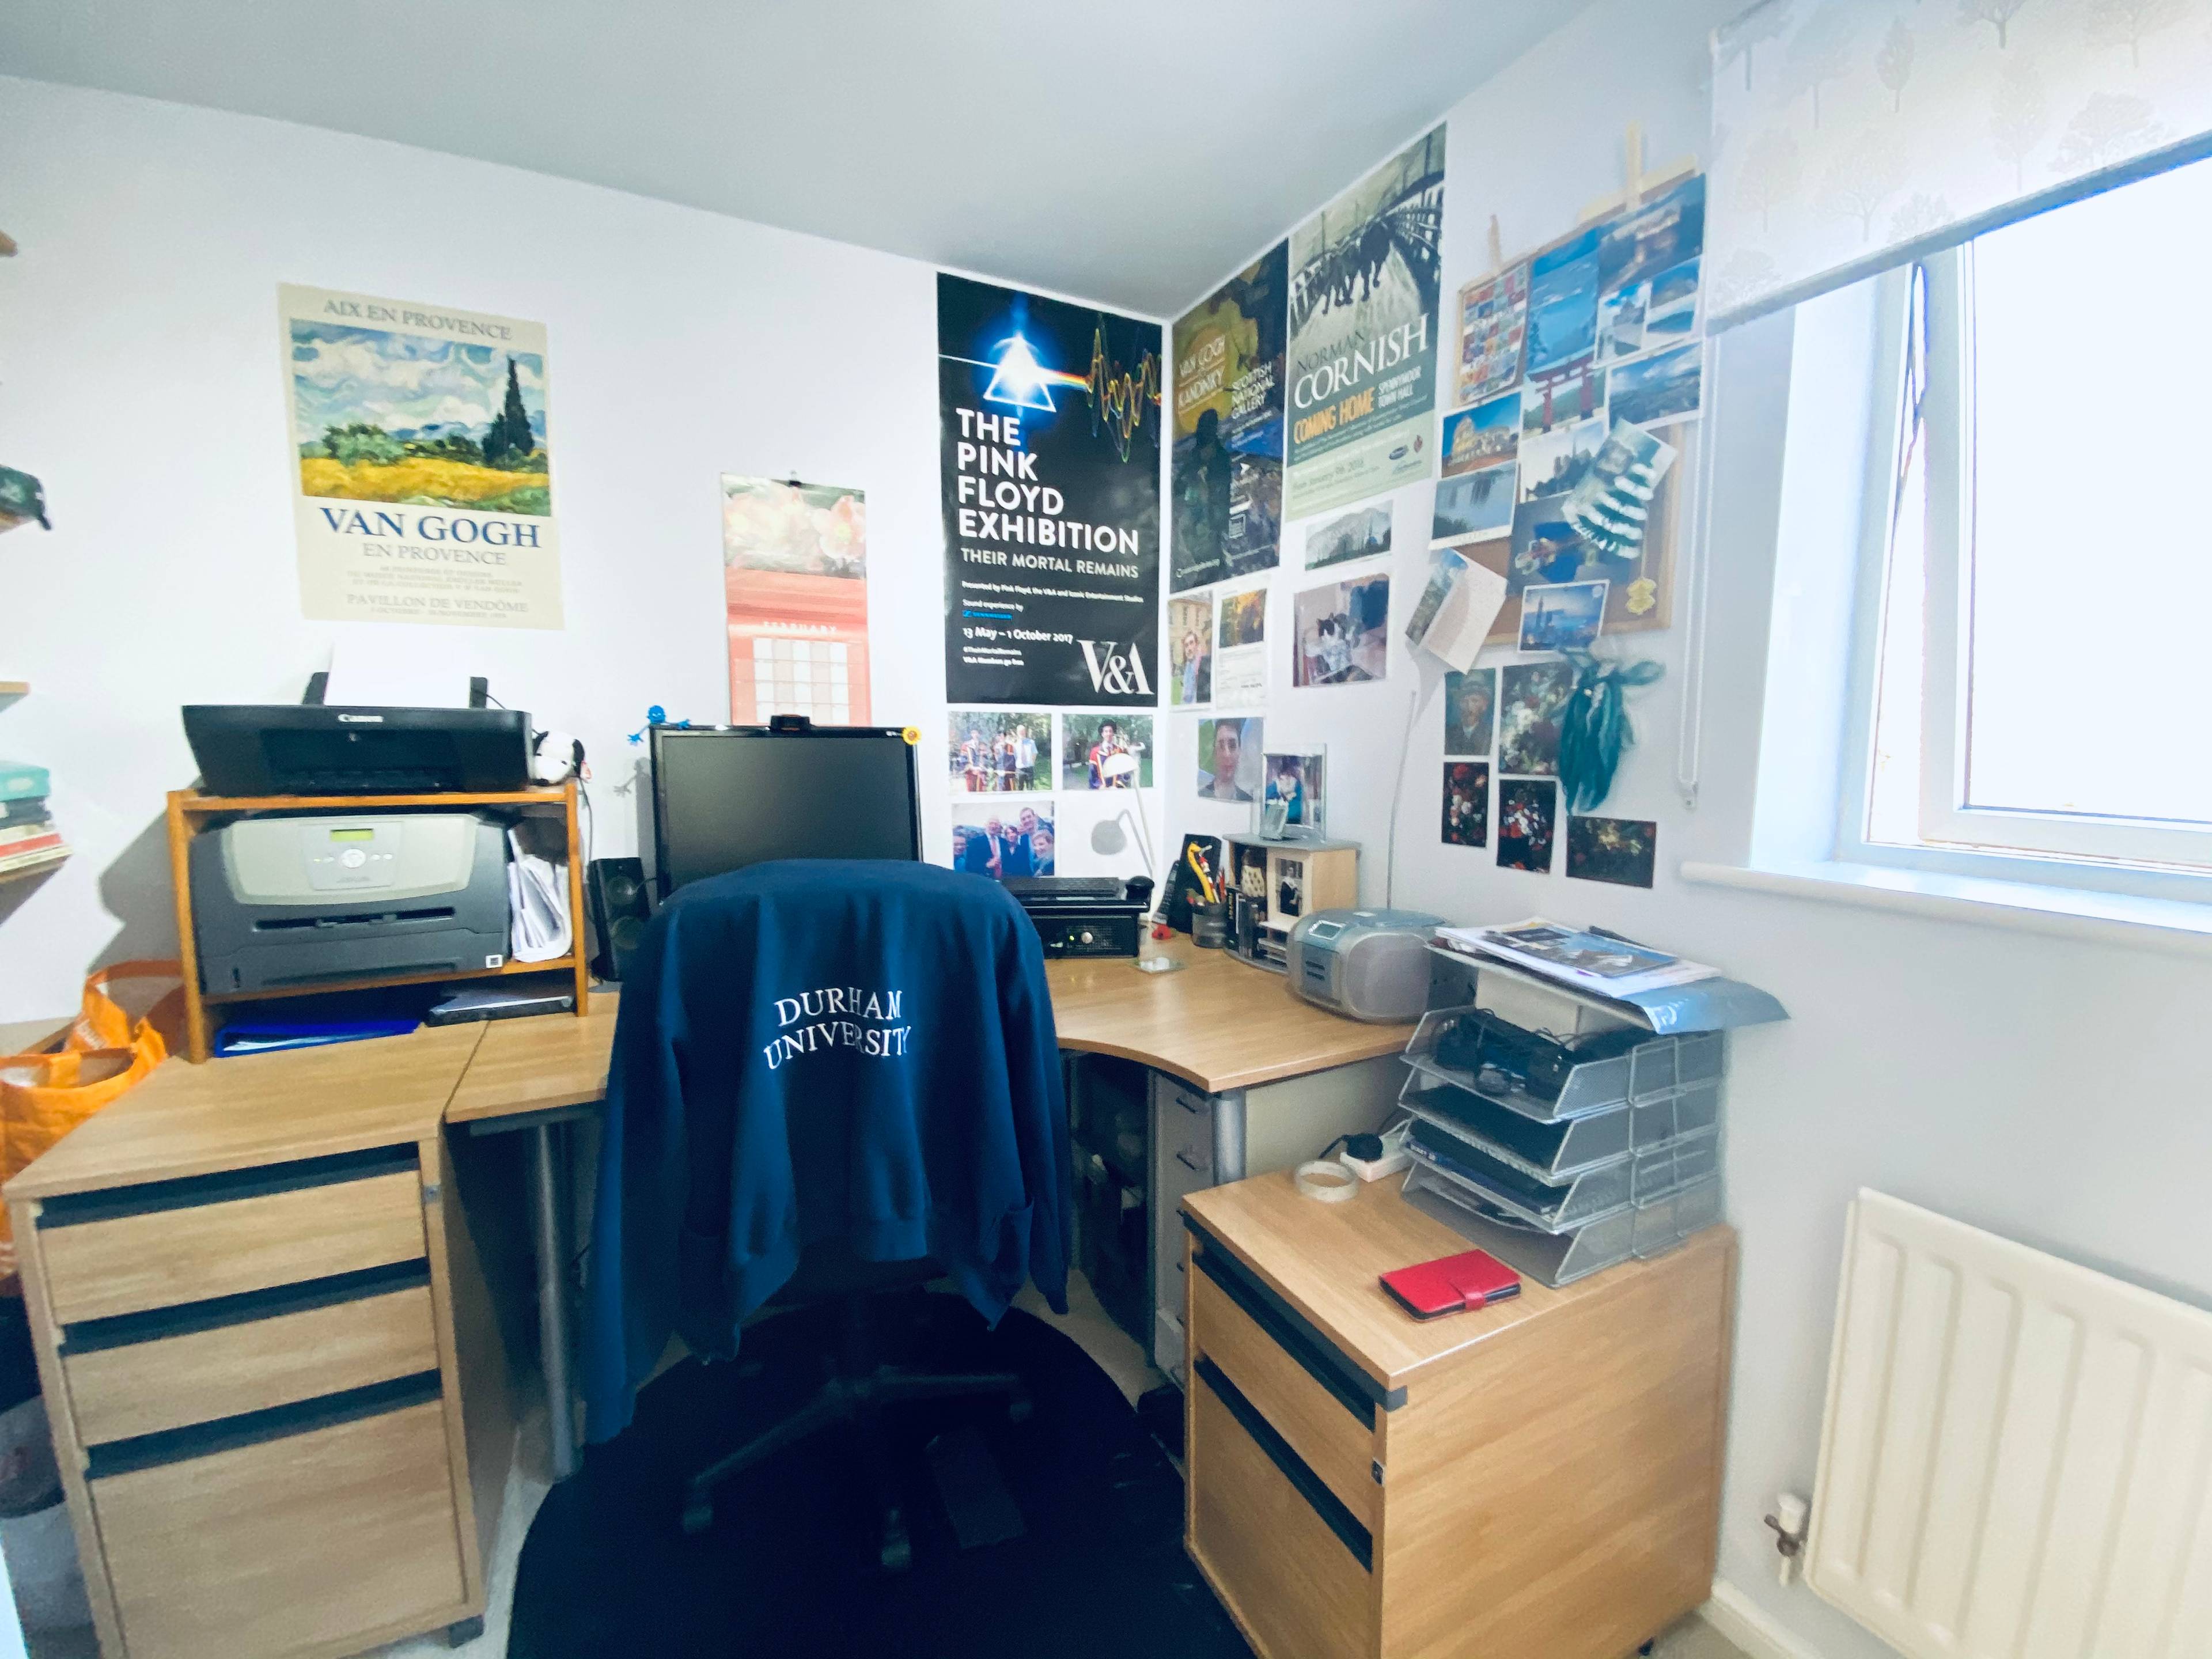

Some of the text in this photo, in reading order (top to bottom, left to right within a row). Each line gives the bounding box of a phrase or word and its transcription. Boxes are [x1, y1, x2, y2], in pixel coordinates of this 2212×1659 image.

[324, 299, 513, 340] AIX EN PROVENCE
[1294, 313, 1430, 408] CORNISH
[1297, 330, 1365, 372] NORMAN
[956, 407, 1021, 446] THE
[1294, 405, 1336, 444] COMING
[1339, 387, 1375, 425] HOME
[957, 441, 1038, 481] PINK
[958, 475, 1065, 516] FLOYD
[320, 507, 543, 548] VAN GOGH
[959, 508, 1138, 556] EXHIBITION
[362, 543, 507, 565] EN PROVENCE
[961, 547, 1139, 578] THEIR MORTAL REMAINS
[346, 593, 528, 612] PAVILLON DE VENDÔME
[962, 627, 974, 639] 13
[974, 626, 998, 641] May
[1006, 630, 1012, 639] 1
[1013, 628, 1052, 642] October
[1052, 632, 1074, 645] 2017
[1077, 639, 1155, 695] V&A
[773, 987, 903, 1027] DURHAM
[763, 1021, 912, 1070] UNIVERSITY
